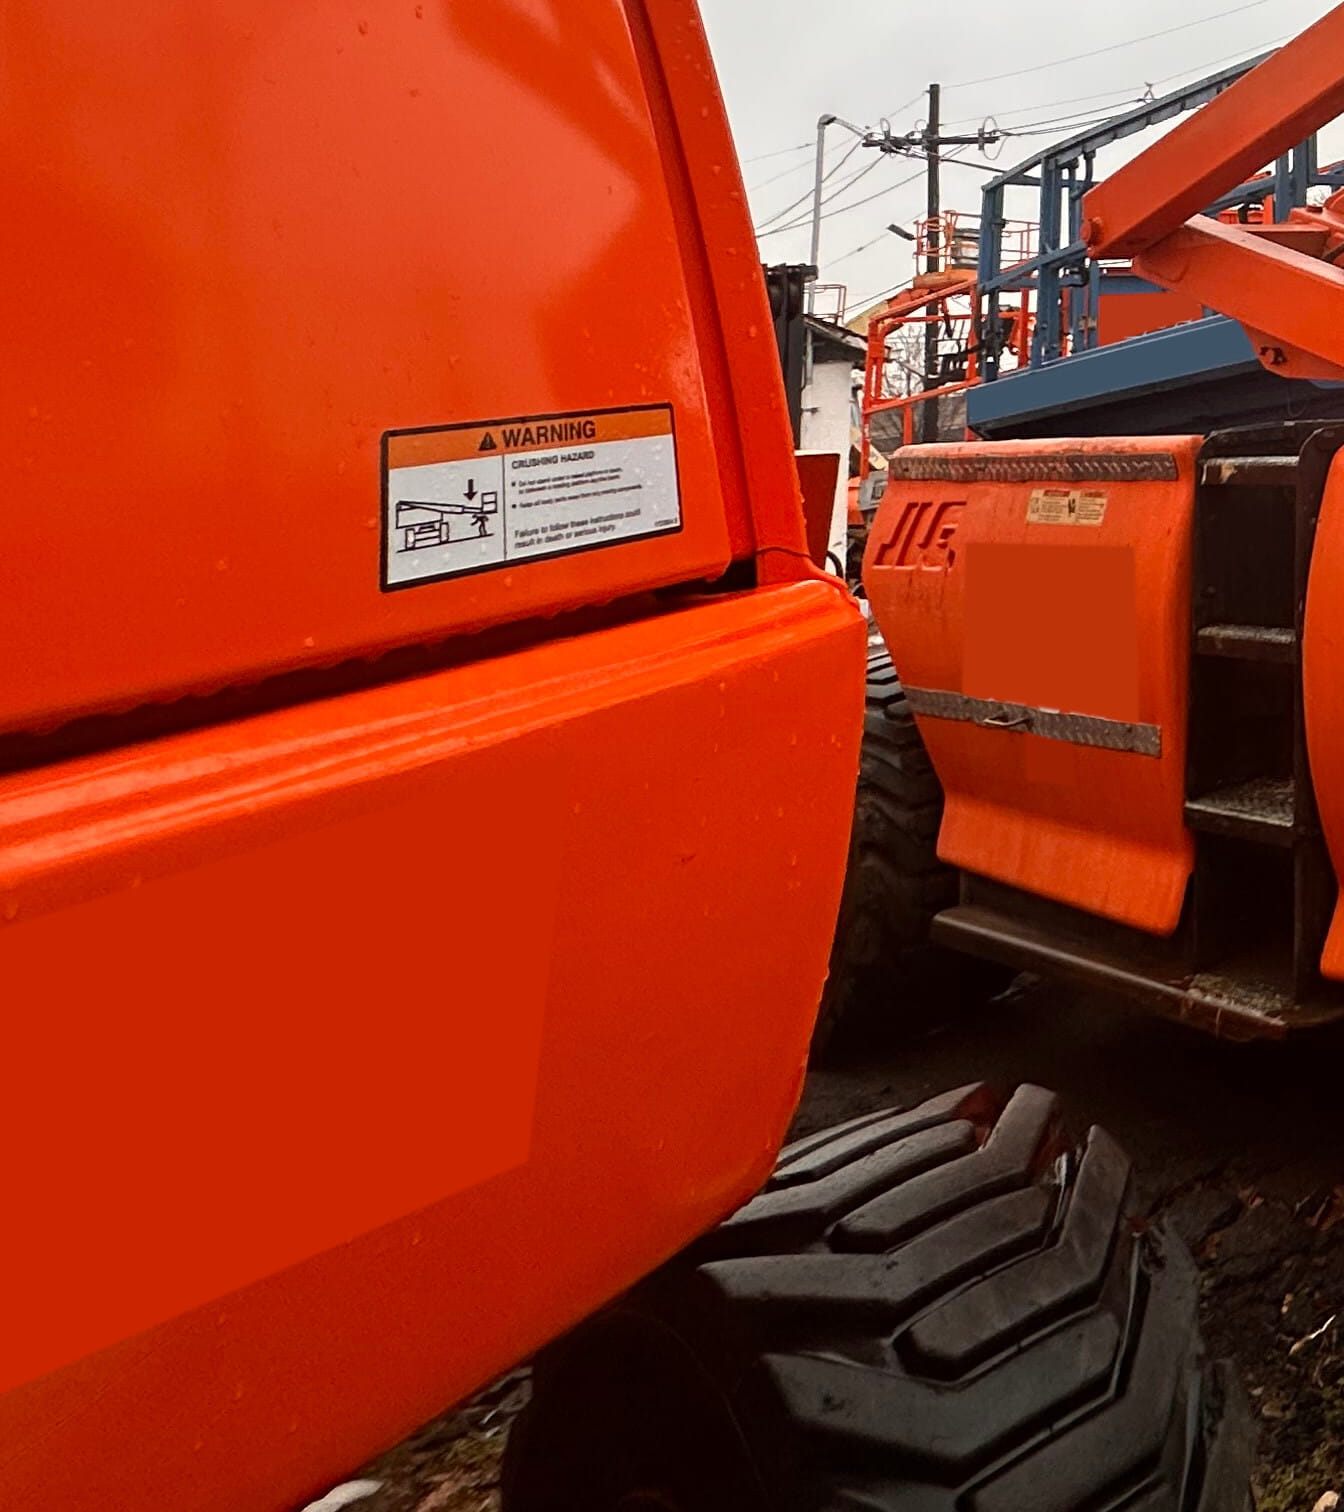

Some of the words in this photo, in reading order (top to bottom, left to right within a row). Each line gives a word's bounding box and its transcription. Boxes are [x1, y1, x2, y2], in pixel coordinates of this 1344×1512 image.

[502, 420, 596, 448] WARNING
[512, 455, 558, 469] CRUSHING
[560, 450, 595, 464] HAZARD
[872, 500, 967, 573] JLG
